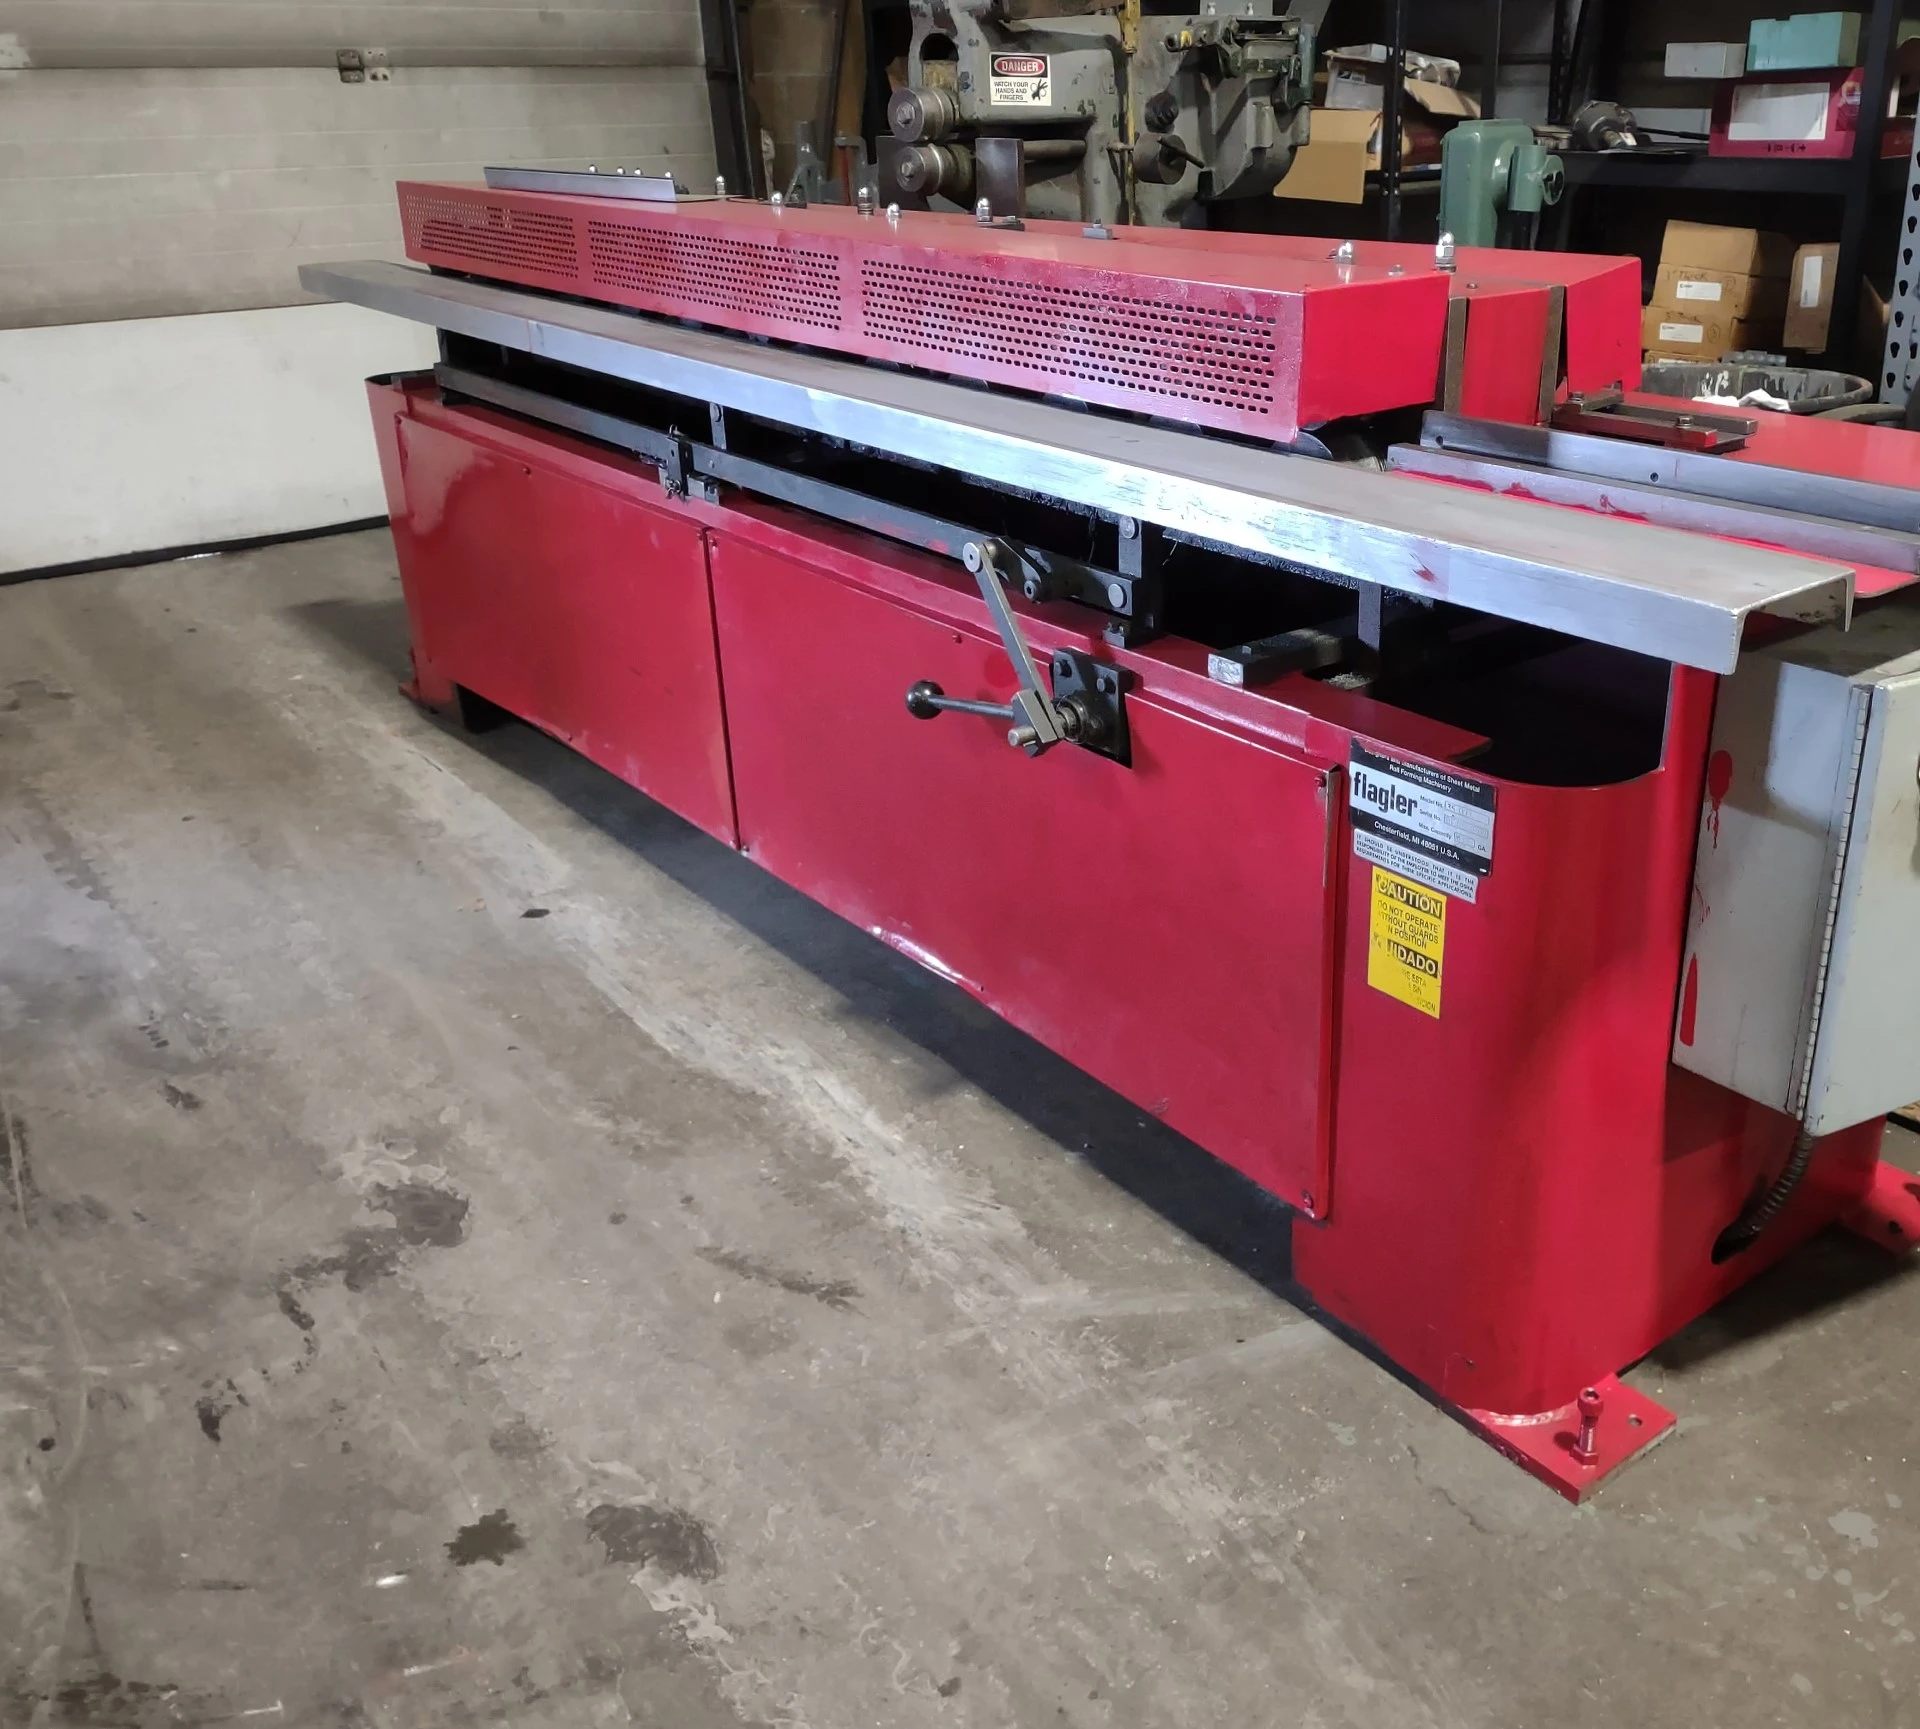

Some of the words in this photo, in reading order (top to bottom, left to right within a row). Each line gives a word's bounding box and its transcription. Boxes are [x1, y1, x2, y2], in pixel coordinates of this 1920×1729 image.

[1002, 60, 1038, 71] DANGER
[1389, 763, 1400, 774] Roll
[1400, 767, 1423, 783] Forming
[1423, 776, 1452, 793] Machinery
[1440, 773, 1447, 781] of
[1447, 775, 1463, 787] Sheet
[1464, 781, 1481, 793] Metal
[1354, 771, 1418, 817] flagler
[1374, 820, 1411, 842] Chesterfield,
[1411, 835, 1420, 845] MI
[1440, 846, 1460, 861] U.S.A.
[1378, 879, 1442, 917] CAUTION
[1388, 904, 1403, 918] NOT
[1404, 911, 1439, 934] OPERATE
[1408, 924, 1439, 944] GUARDS
[1394, 928, 1427, 949] POSITION
